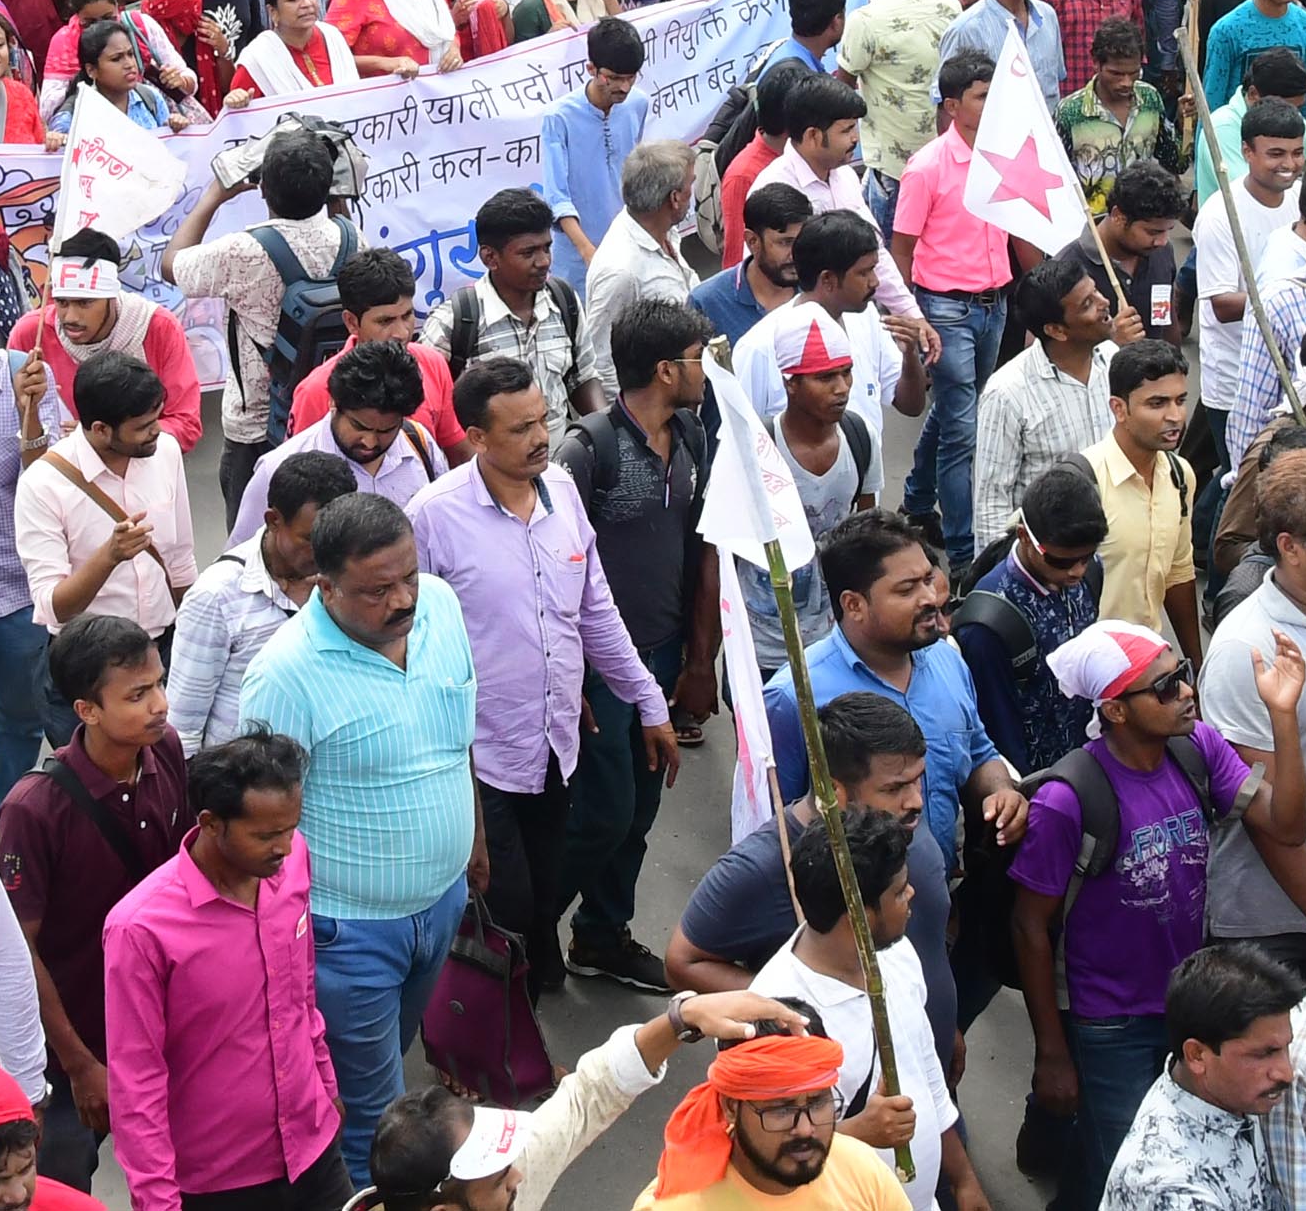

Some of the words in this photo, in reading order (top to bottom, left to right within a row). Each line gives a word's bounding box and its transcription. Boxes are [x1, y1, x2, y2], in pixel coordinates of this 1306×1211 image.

[358, 151, 421, 213] रकारी
[650, 80, 700, 118] बेचना
[423, 79, 500, 125] खाली
